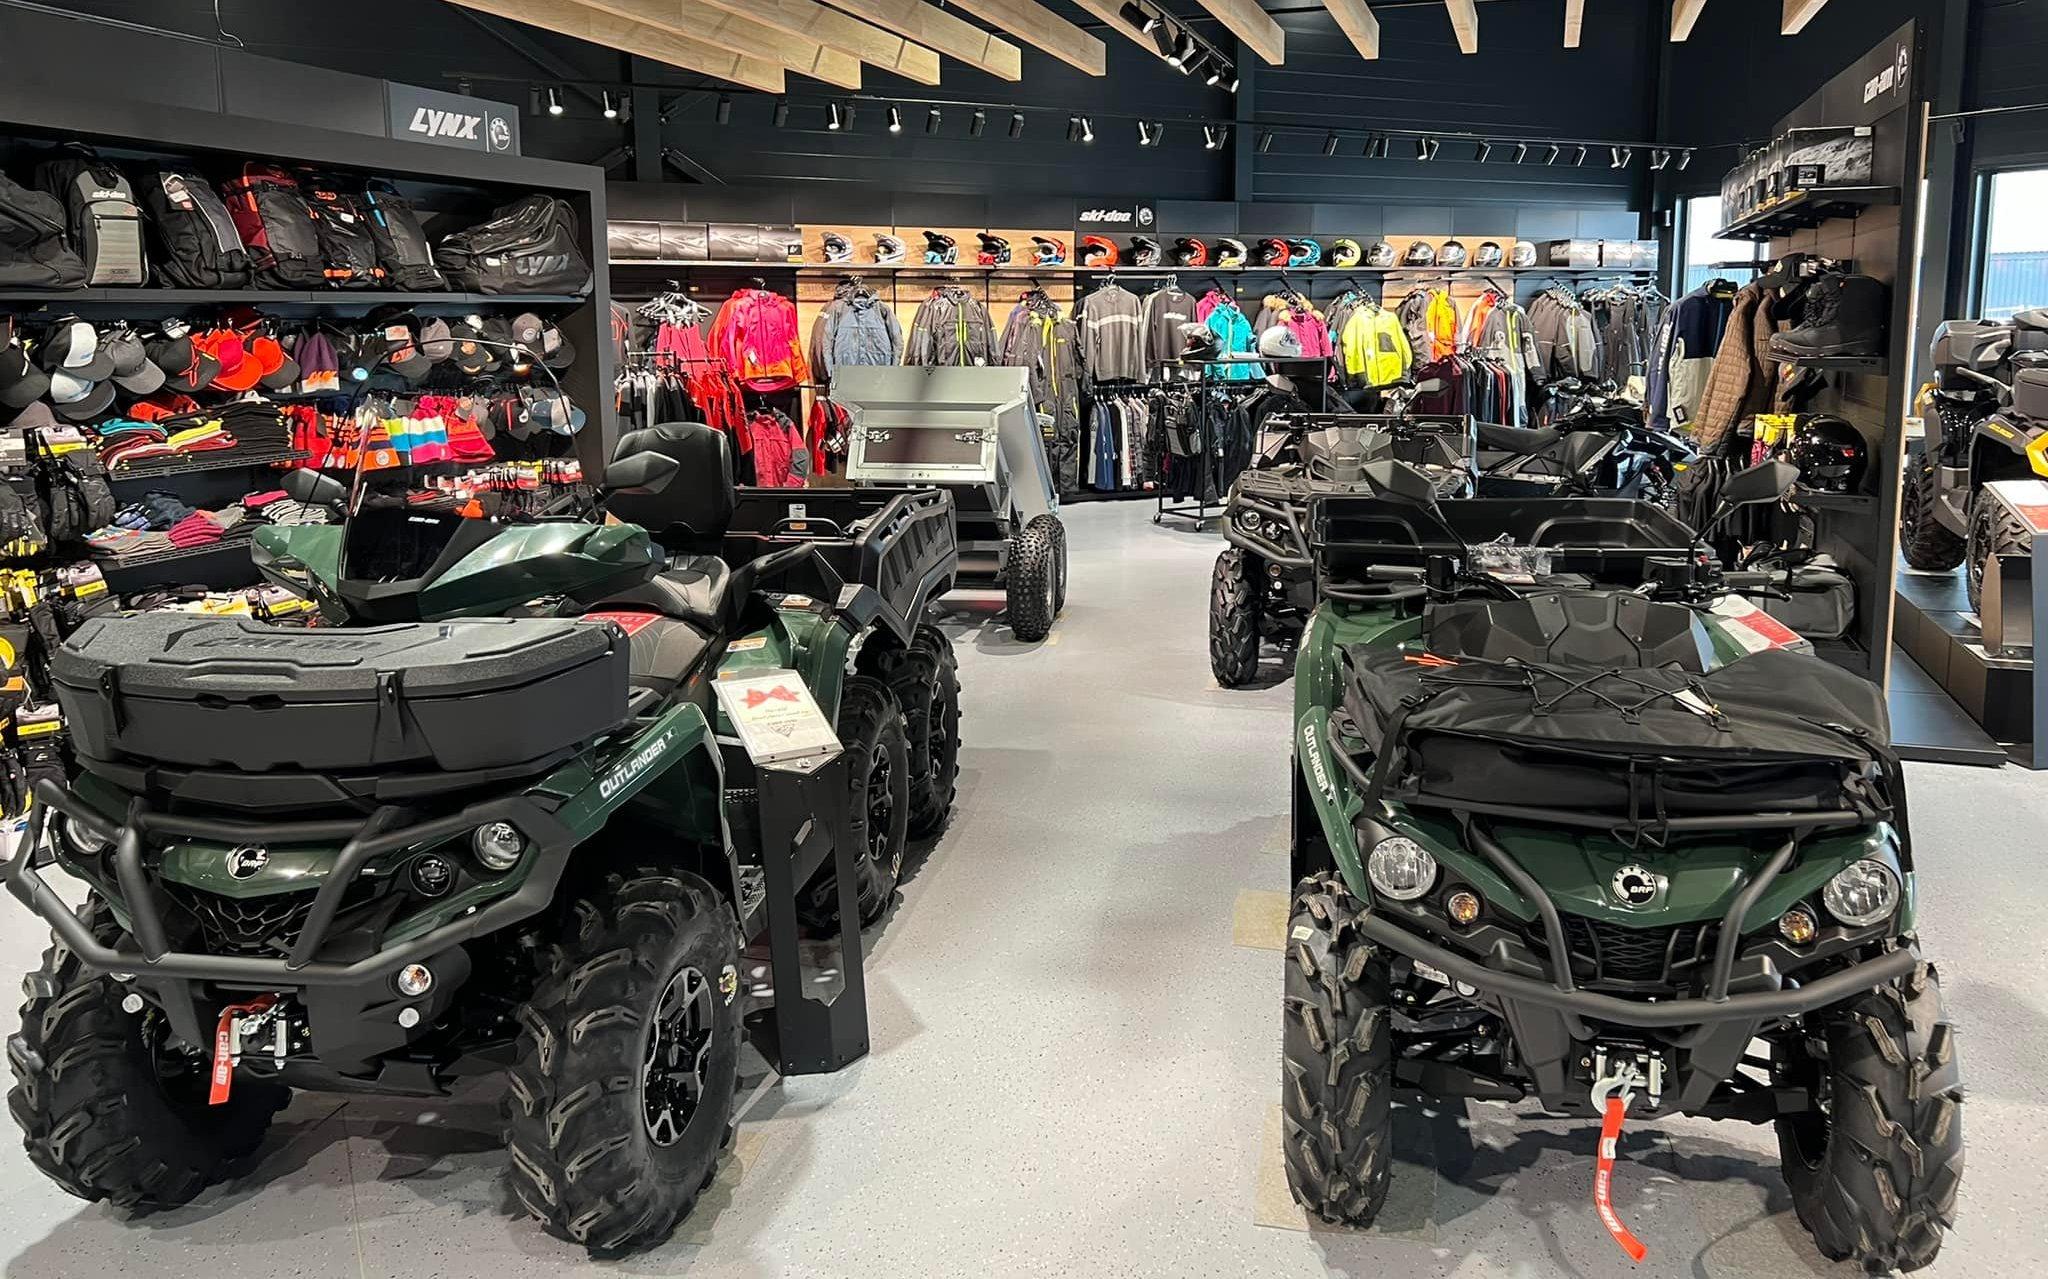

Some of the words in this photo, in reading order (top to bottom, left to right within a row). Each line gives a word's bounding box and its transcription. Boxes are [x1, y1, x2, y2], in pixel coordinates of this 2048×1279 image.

[409, 107, 481, 140] LYNX
[1079, 209, 1132, 222] ski-doo
[599, 737, 666, 799] OUTLANDER
[1303, 724, 1329, 793] OUTLANDER
[215, 1031, 229, 1086] can-am
[1597, 1169, 1623, 1234] can-am
